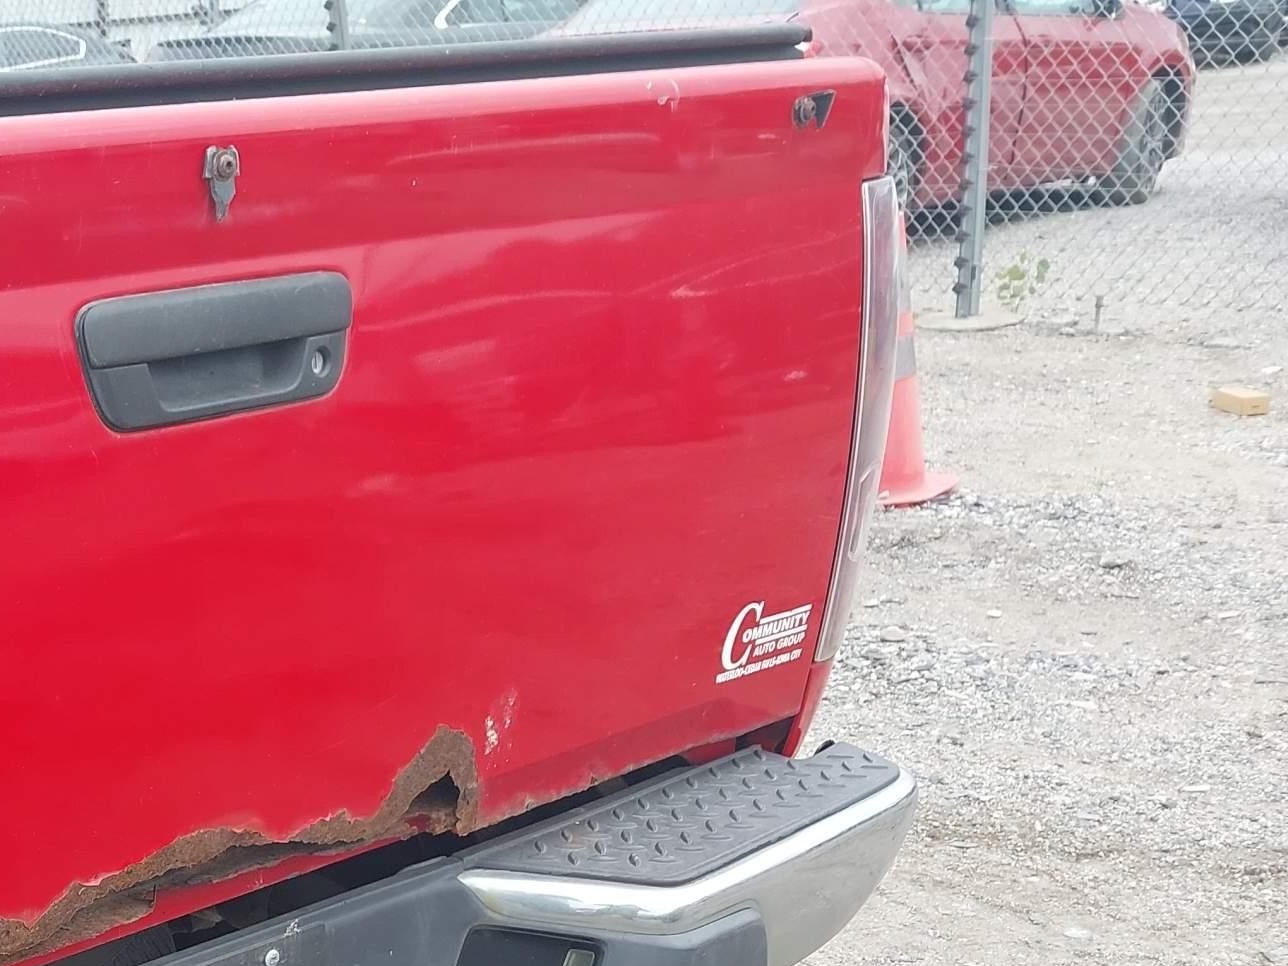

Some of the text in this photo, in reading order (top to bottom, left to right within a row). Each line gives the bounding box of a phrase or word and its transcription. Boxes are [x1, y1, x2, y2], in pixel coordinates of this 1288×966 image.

[721, 600, 810, 671] COMMUNITY
[753, 632, 806, 657] AUTO GROUP
